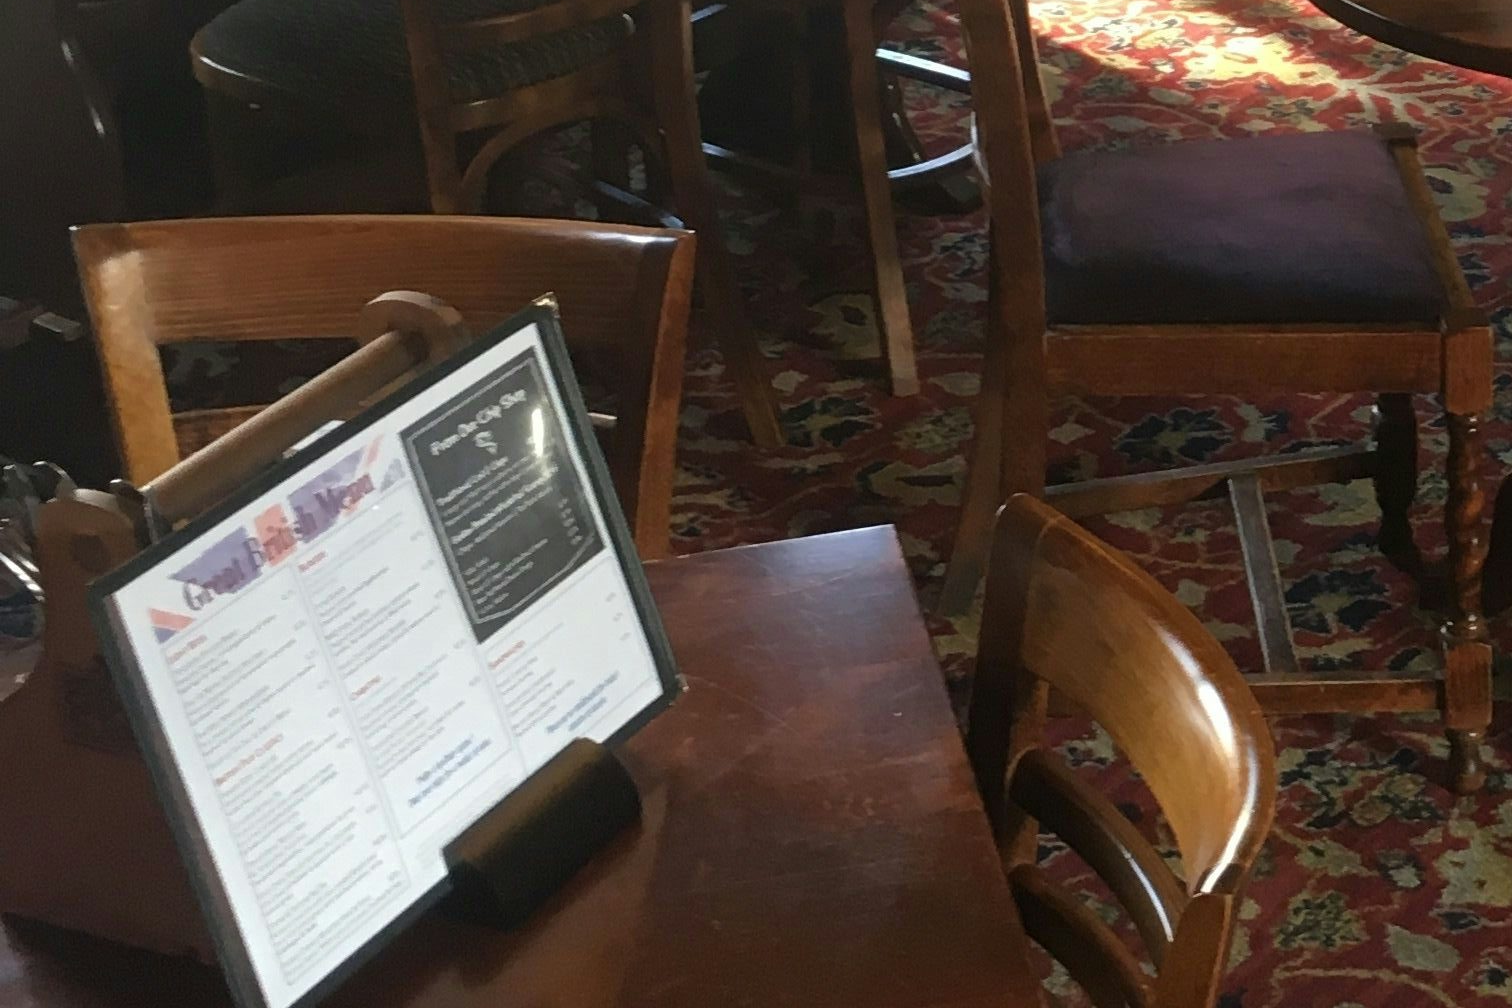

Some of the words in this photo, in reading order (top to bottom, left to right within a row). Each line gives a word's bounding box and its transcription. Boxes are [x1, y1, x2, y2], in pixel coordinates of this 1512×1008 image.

[183, 558, 246, 610] Great
[245, 505, 318, 570] British
[315, 473, 375, 517] Menu
